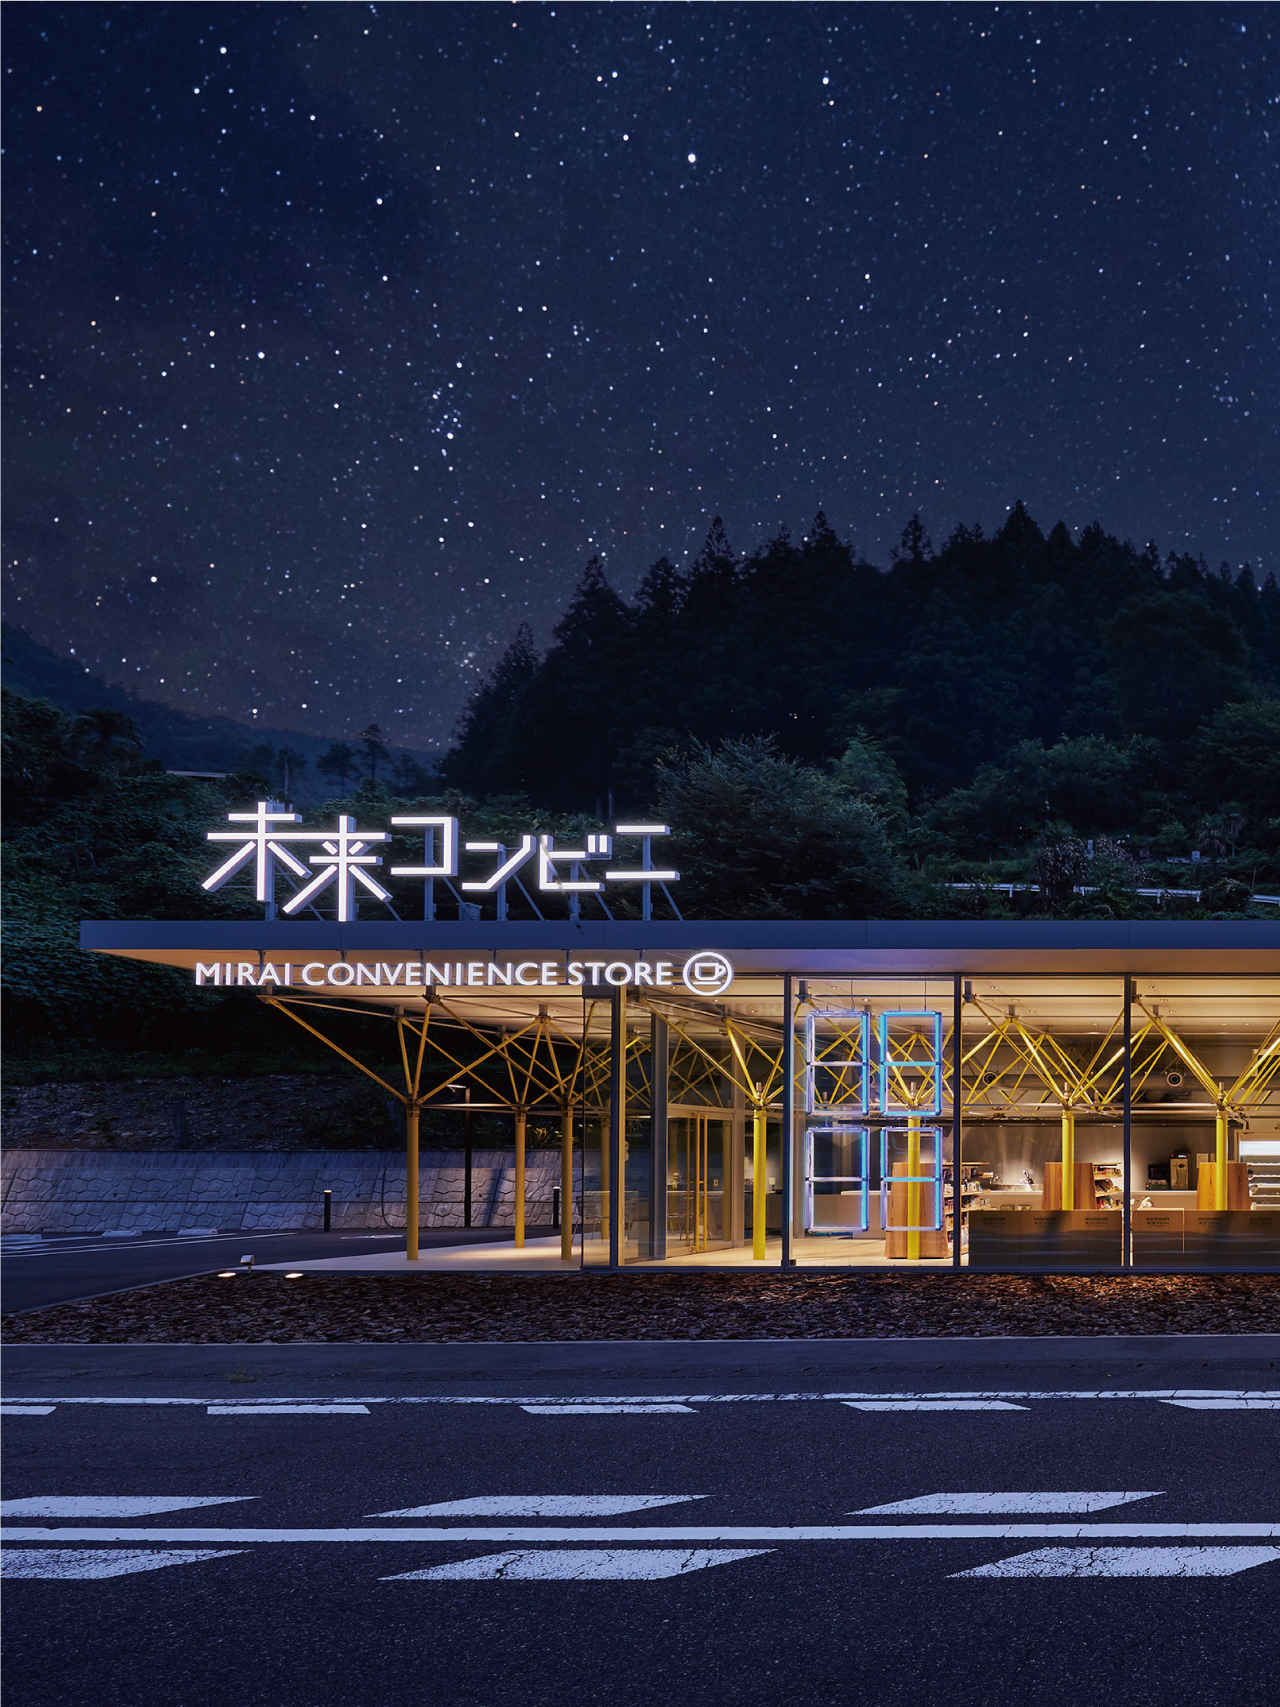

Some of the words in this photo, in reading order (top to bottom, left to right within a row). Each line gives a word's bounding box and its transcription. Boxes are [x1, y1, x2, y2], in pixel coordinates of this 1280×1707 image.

[201, 801, 680, 922] 未来コンビニ
[195, 962, 291, 986] MIRAI
[302, 962, 558, 986] CONVENIENCE
[568, 962, 673, 986] STORE
